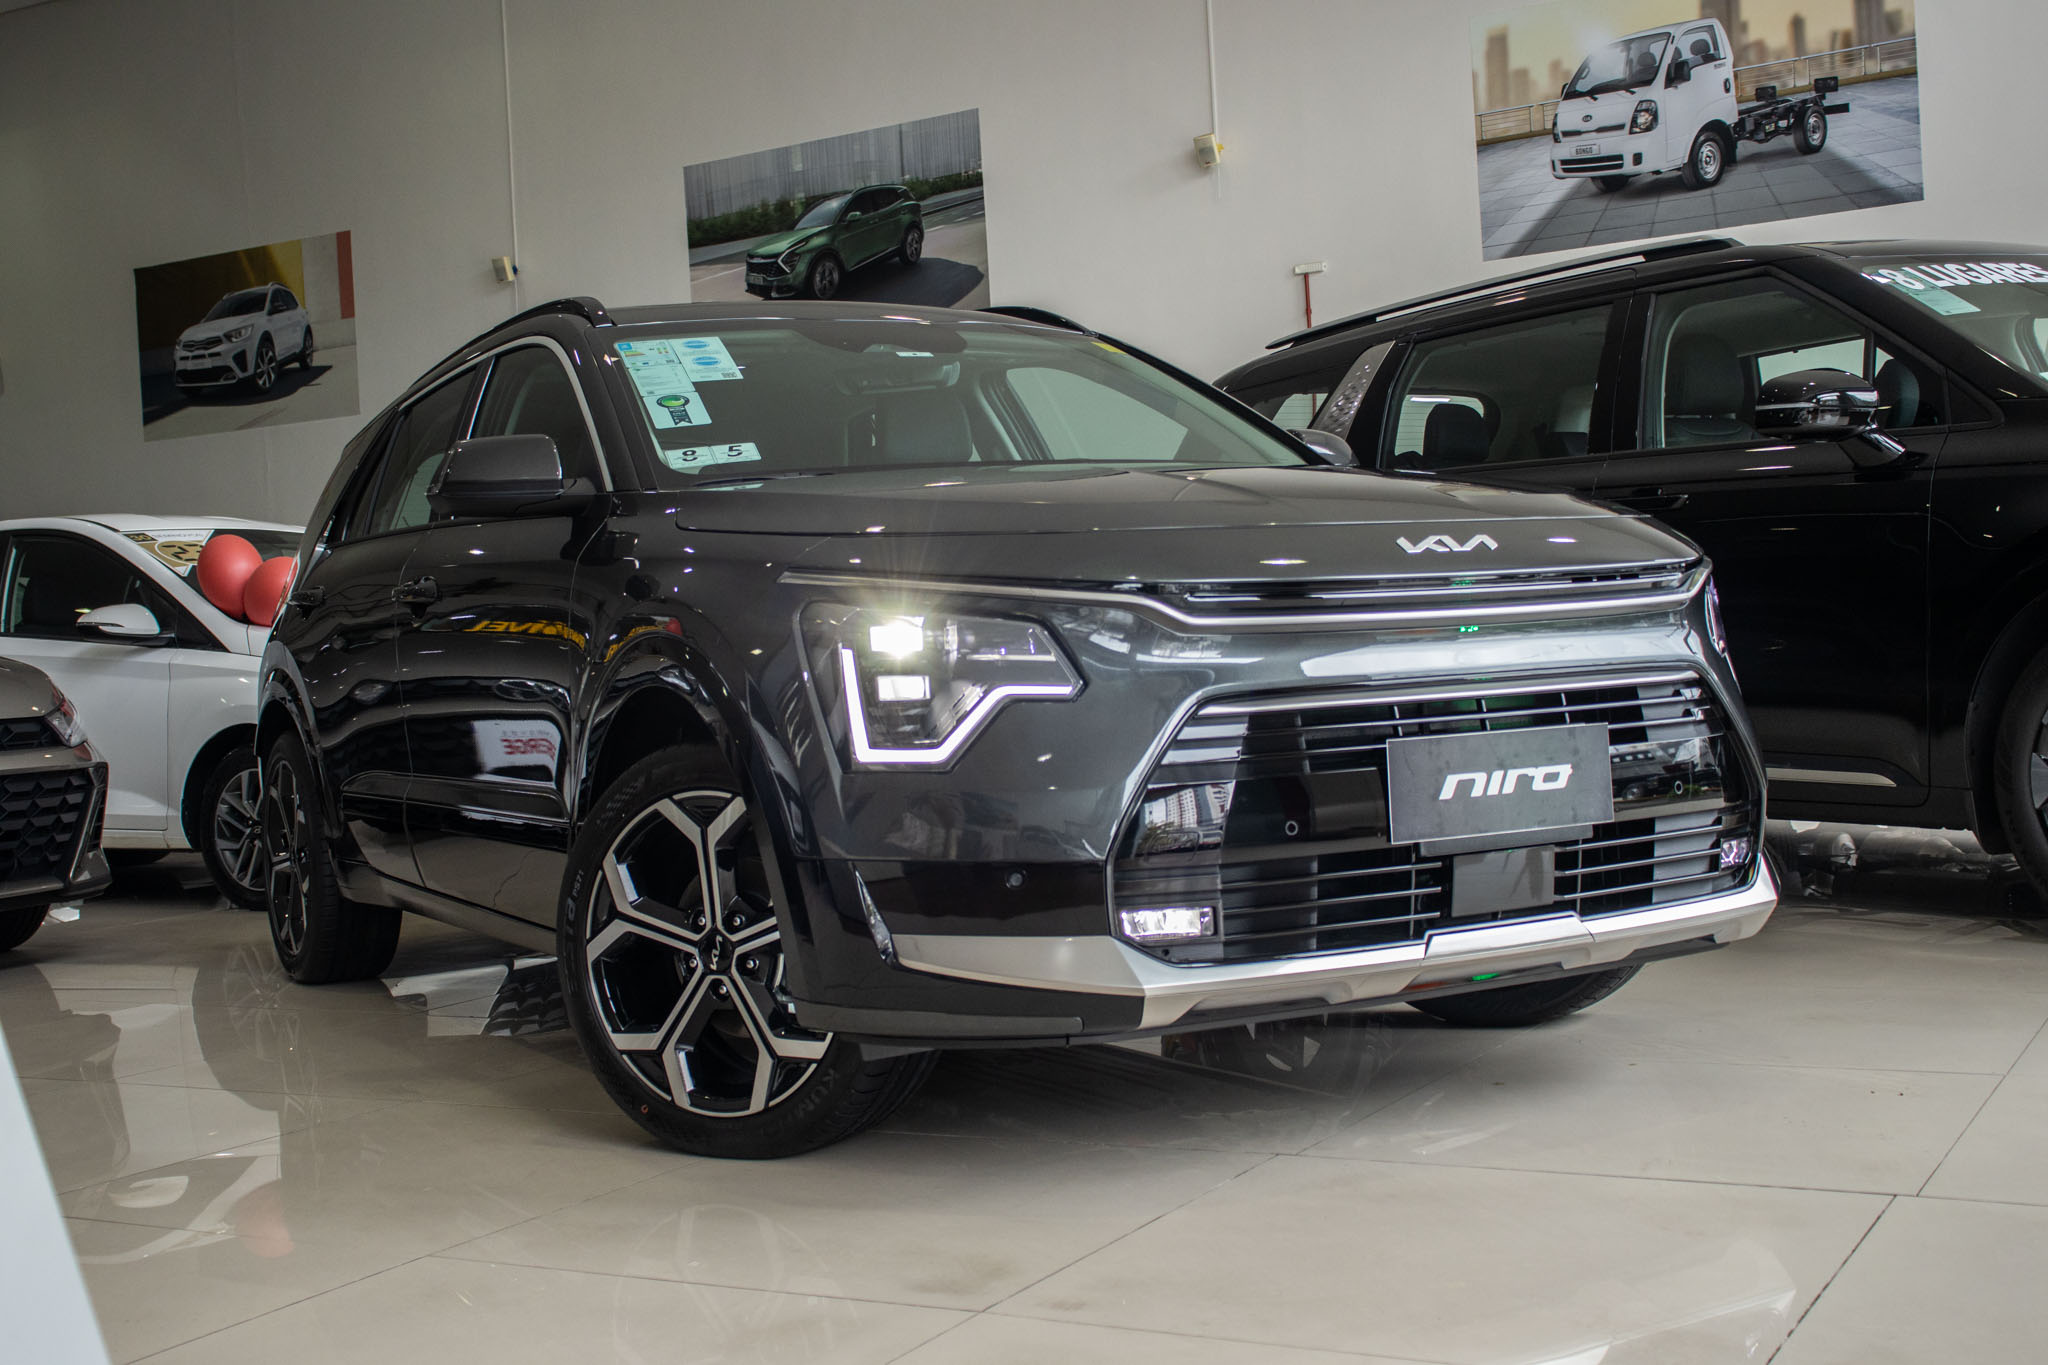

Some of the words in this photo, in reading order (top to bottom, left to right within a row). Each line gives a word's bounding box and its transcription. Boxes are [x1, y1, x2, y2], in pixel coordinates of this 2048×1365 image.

[1878, 269, 1925, 289] 8
[727, 444, 743, 457] 5
[1396, 534, 1498, 553] KIA
[1439, 763, 1573, 800] niro
